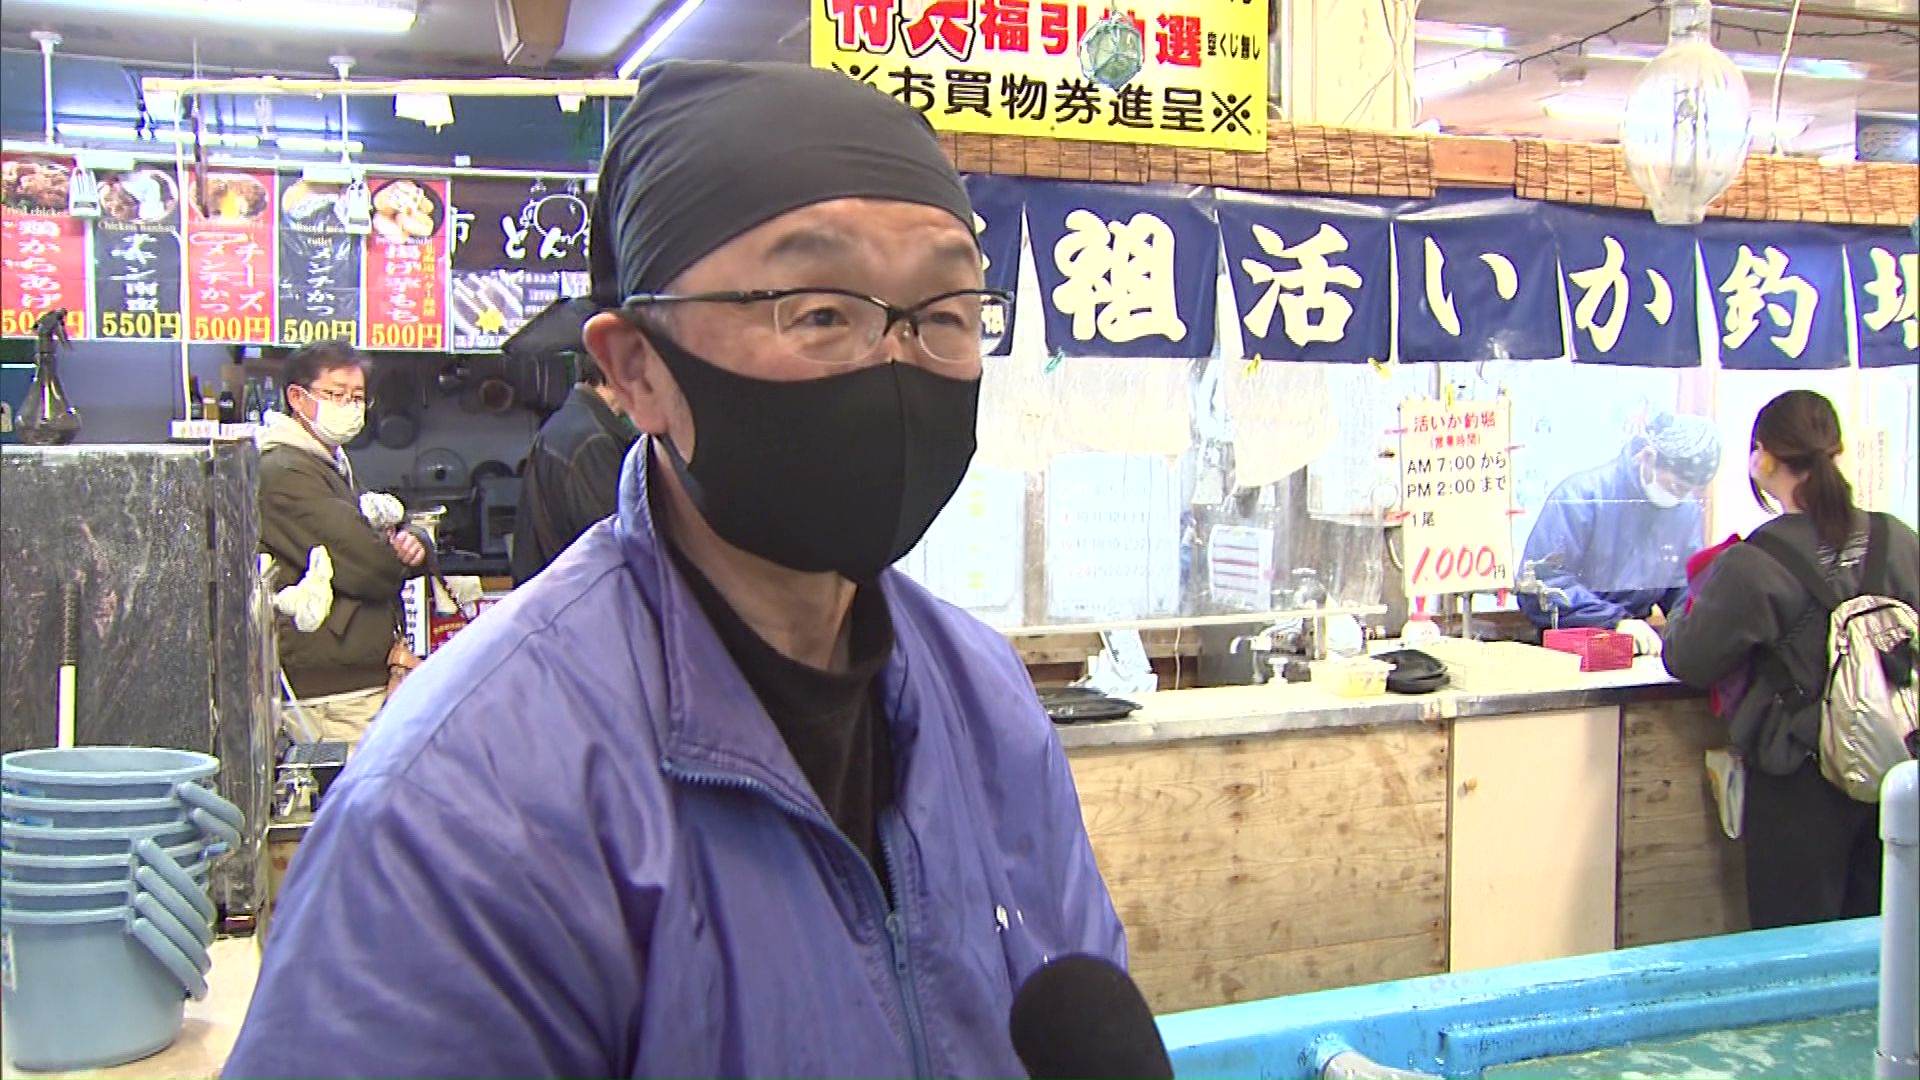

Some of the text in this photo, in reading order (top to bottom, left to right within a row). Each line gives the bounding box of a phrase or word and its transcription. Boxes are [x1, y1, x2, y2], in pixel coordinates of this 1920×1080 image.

[825, 0, 1201, 68] 特大福引選
[1207, 31, 1260, 60] 空くじ無し
[973, 207, 1919, 359] 祖活いか釣
[2, 309, 84, 338] 50円
[102, 311, 180, 338] 550円
[195, 316, 271, 342] 500円
[283, 319, 357, 345] 500円
[371, 322, 442, 348] 500円
[1413, 411, 1496, 433] 活いか釣堀
[1407, 451, 1507, 474] AM 7:00 から
[1407, 475, 1507, 499] PM 2:00 まで
